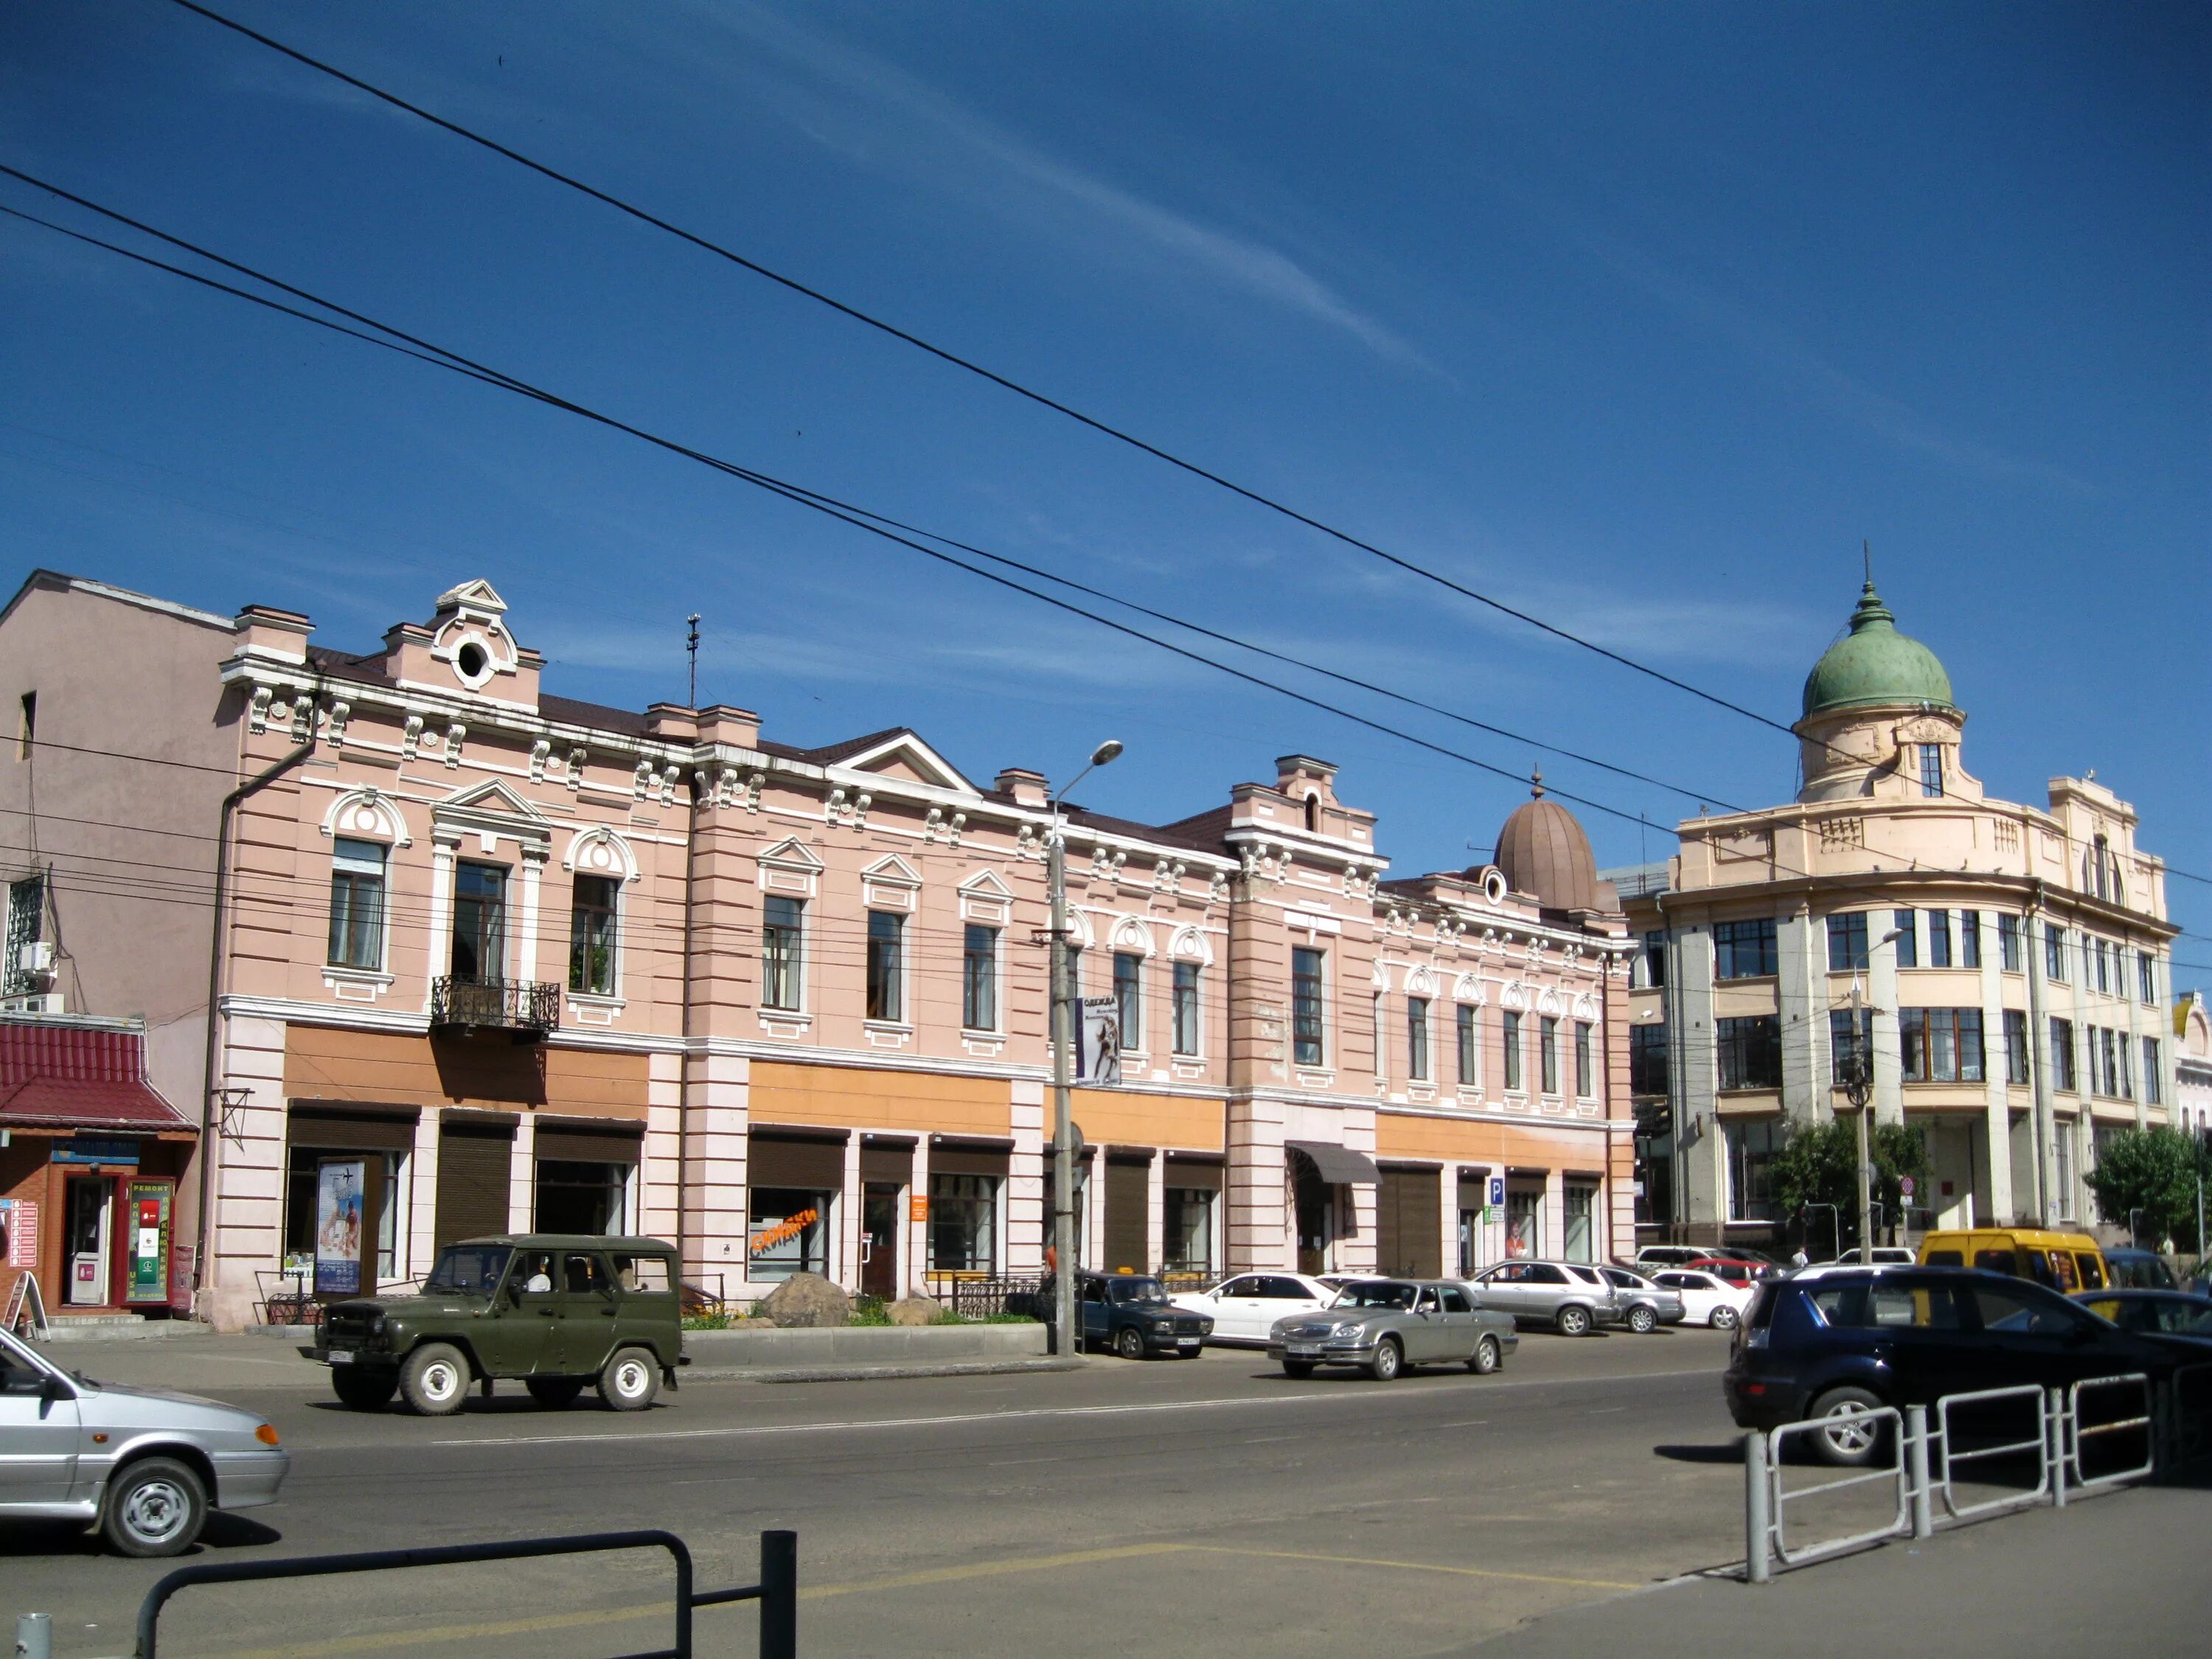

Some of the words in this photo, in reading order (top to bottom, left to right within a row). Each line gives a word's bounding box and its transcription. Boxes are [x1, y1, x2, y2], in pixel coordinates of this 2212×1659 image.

[1085, 997, 1116, 1007] ОДЕЖДА
[1493, 1182, 1501, 1202] P
[131, 1203, 139, 1251] ОПЛАТА
[159, 1197, 169, 1289] ПОДКЛЮЧЕНИЕ
[751, 1207, 818, 1252] СКИДКИ
